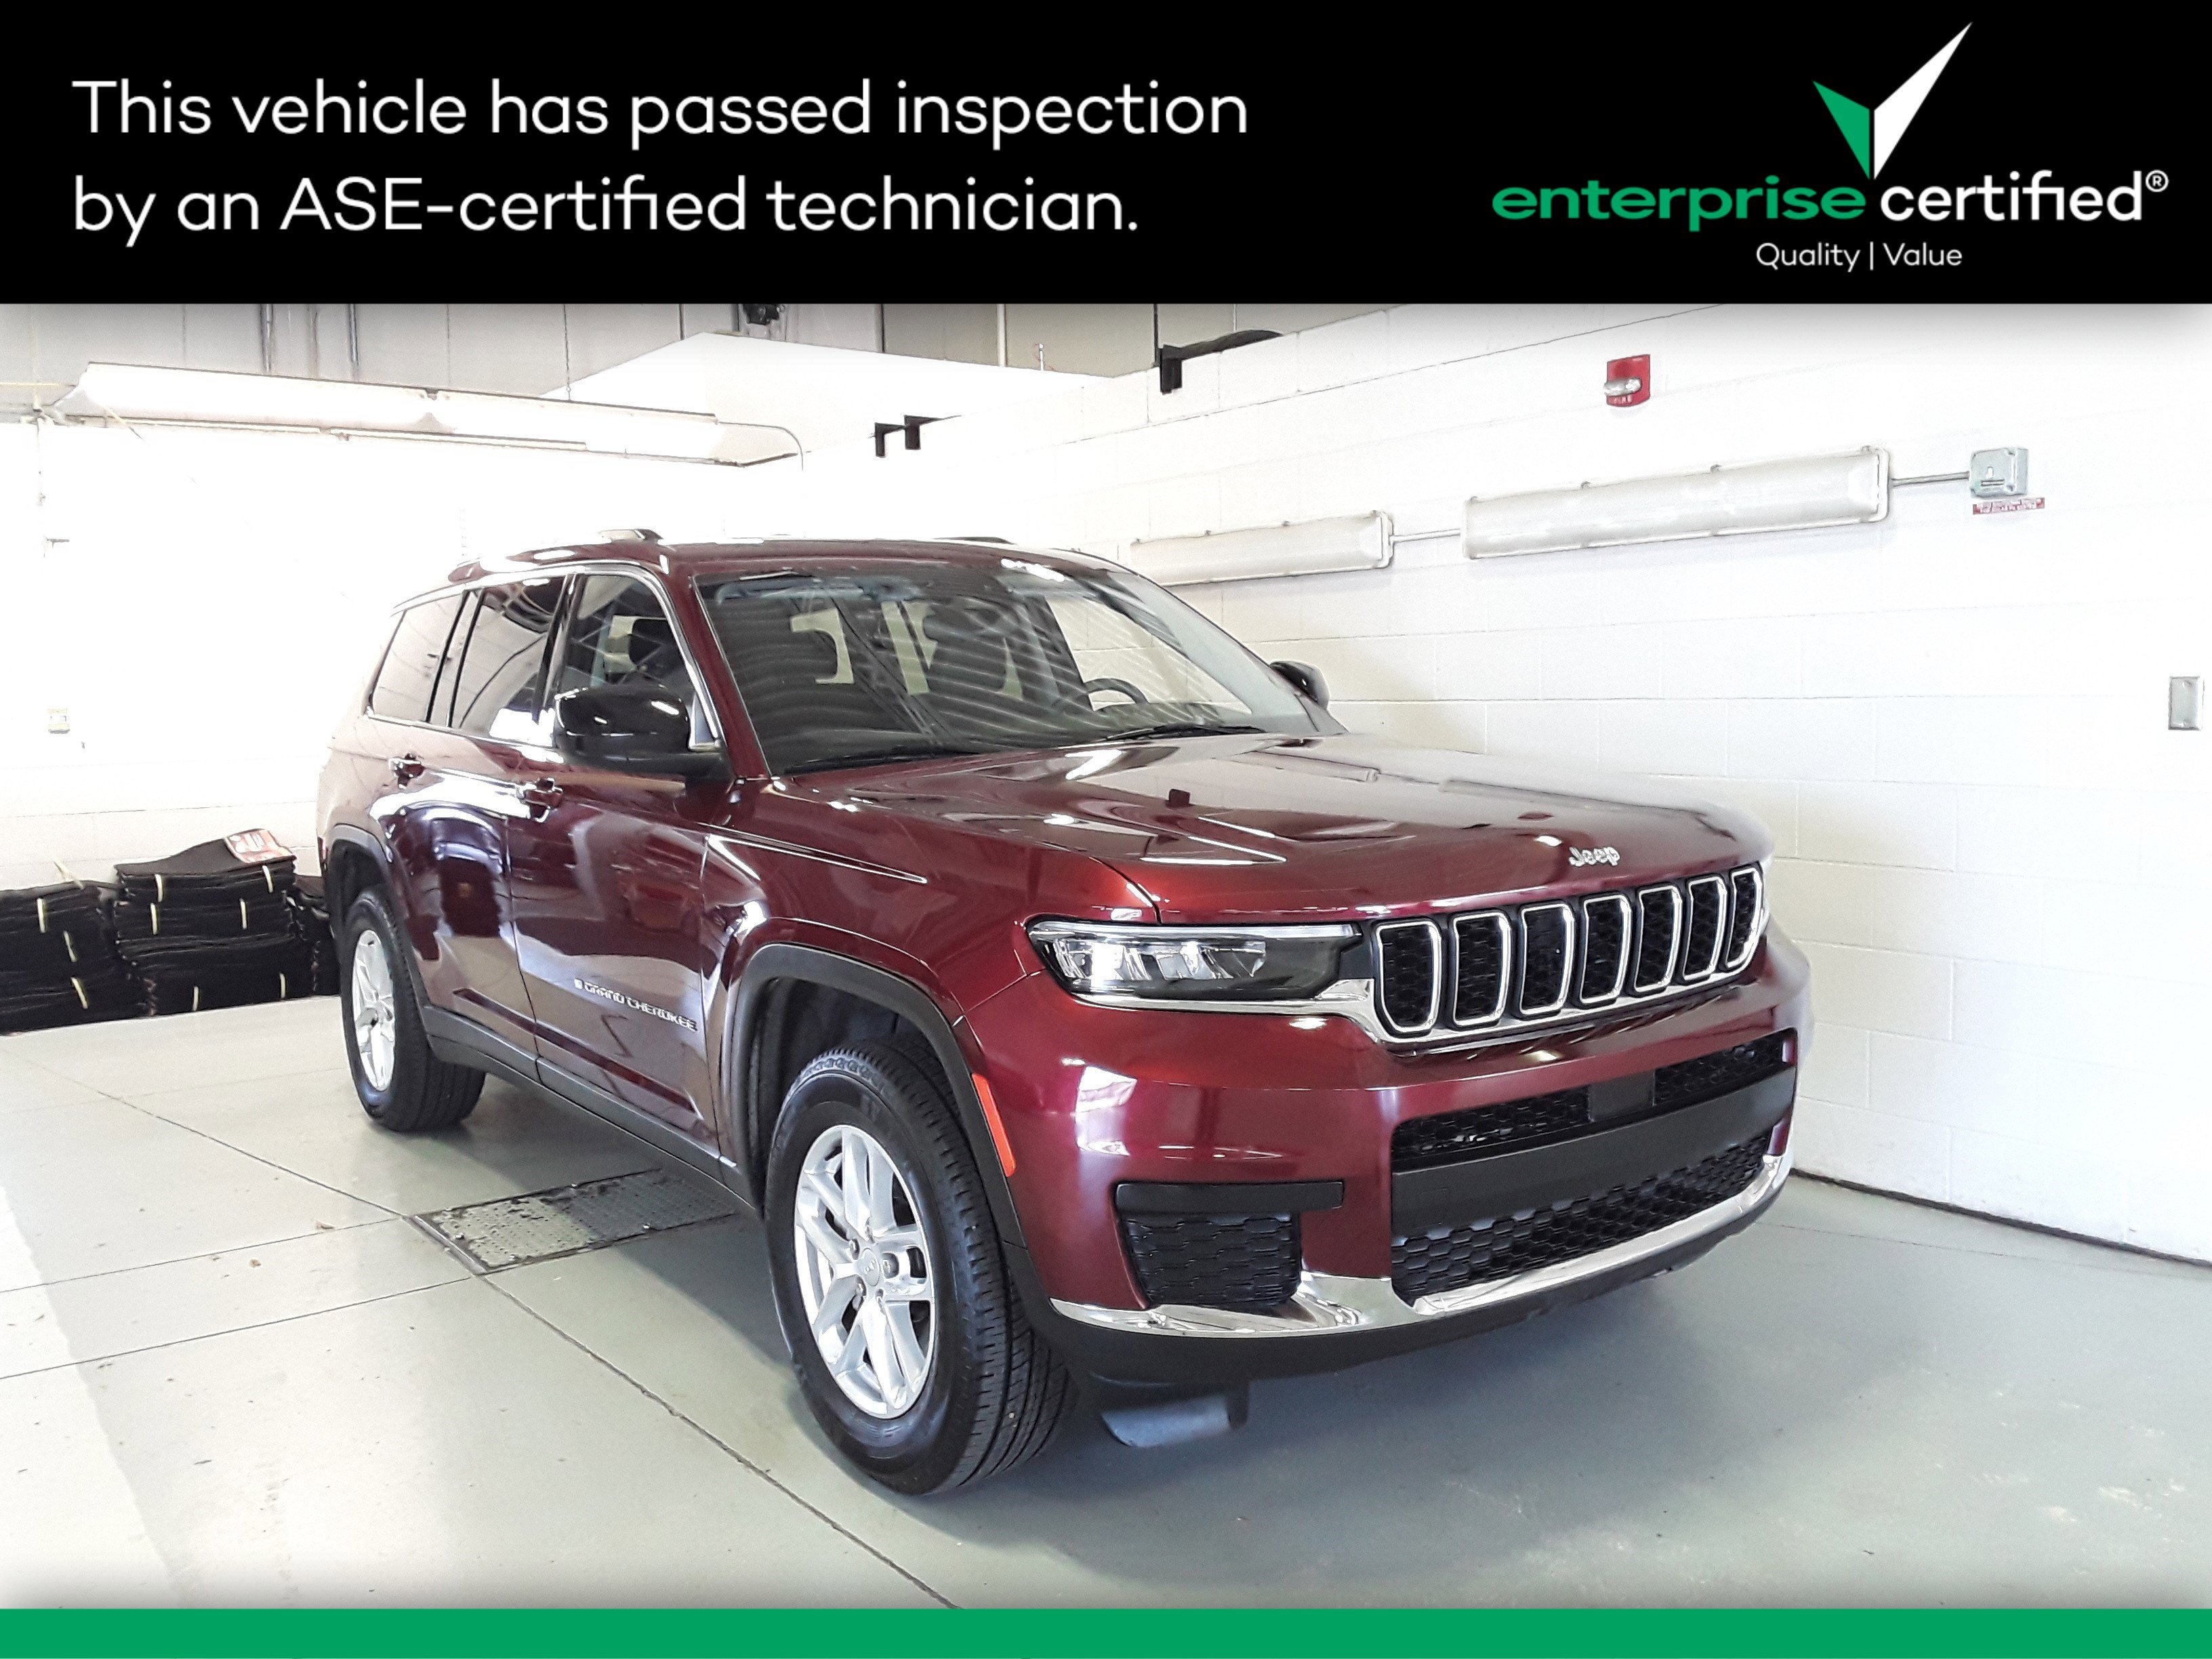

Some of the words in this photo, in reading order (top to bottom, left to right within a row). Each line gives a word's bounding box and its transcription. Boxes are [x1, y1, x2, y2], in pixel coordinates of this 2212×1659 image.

[1568, 846, 1620, 867] Jeep
[584, 982, 625, 1004] GRAND
[626, 997, 698, 1033] CHEROKEE
